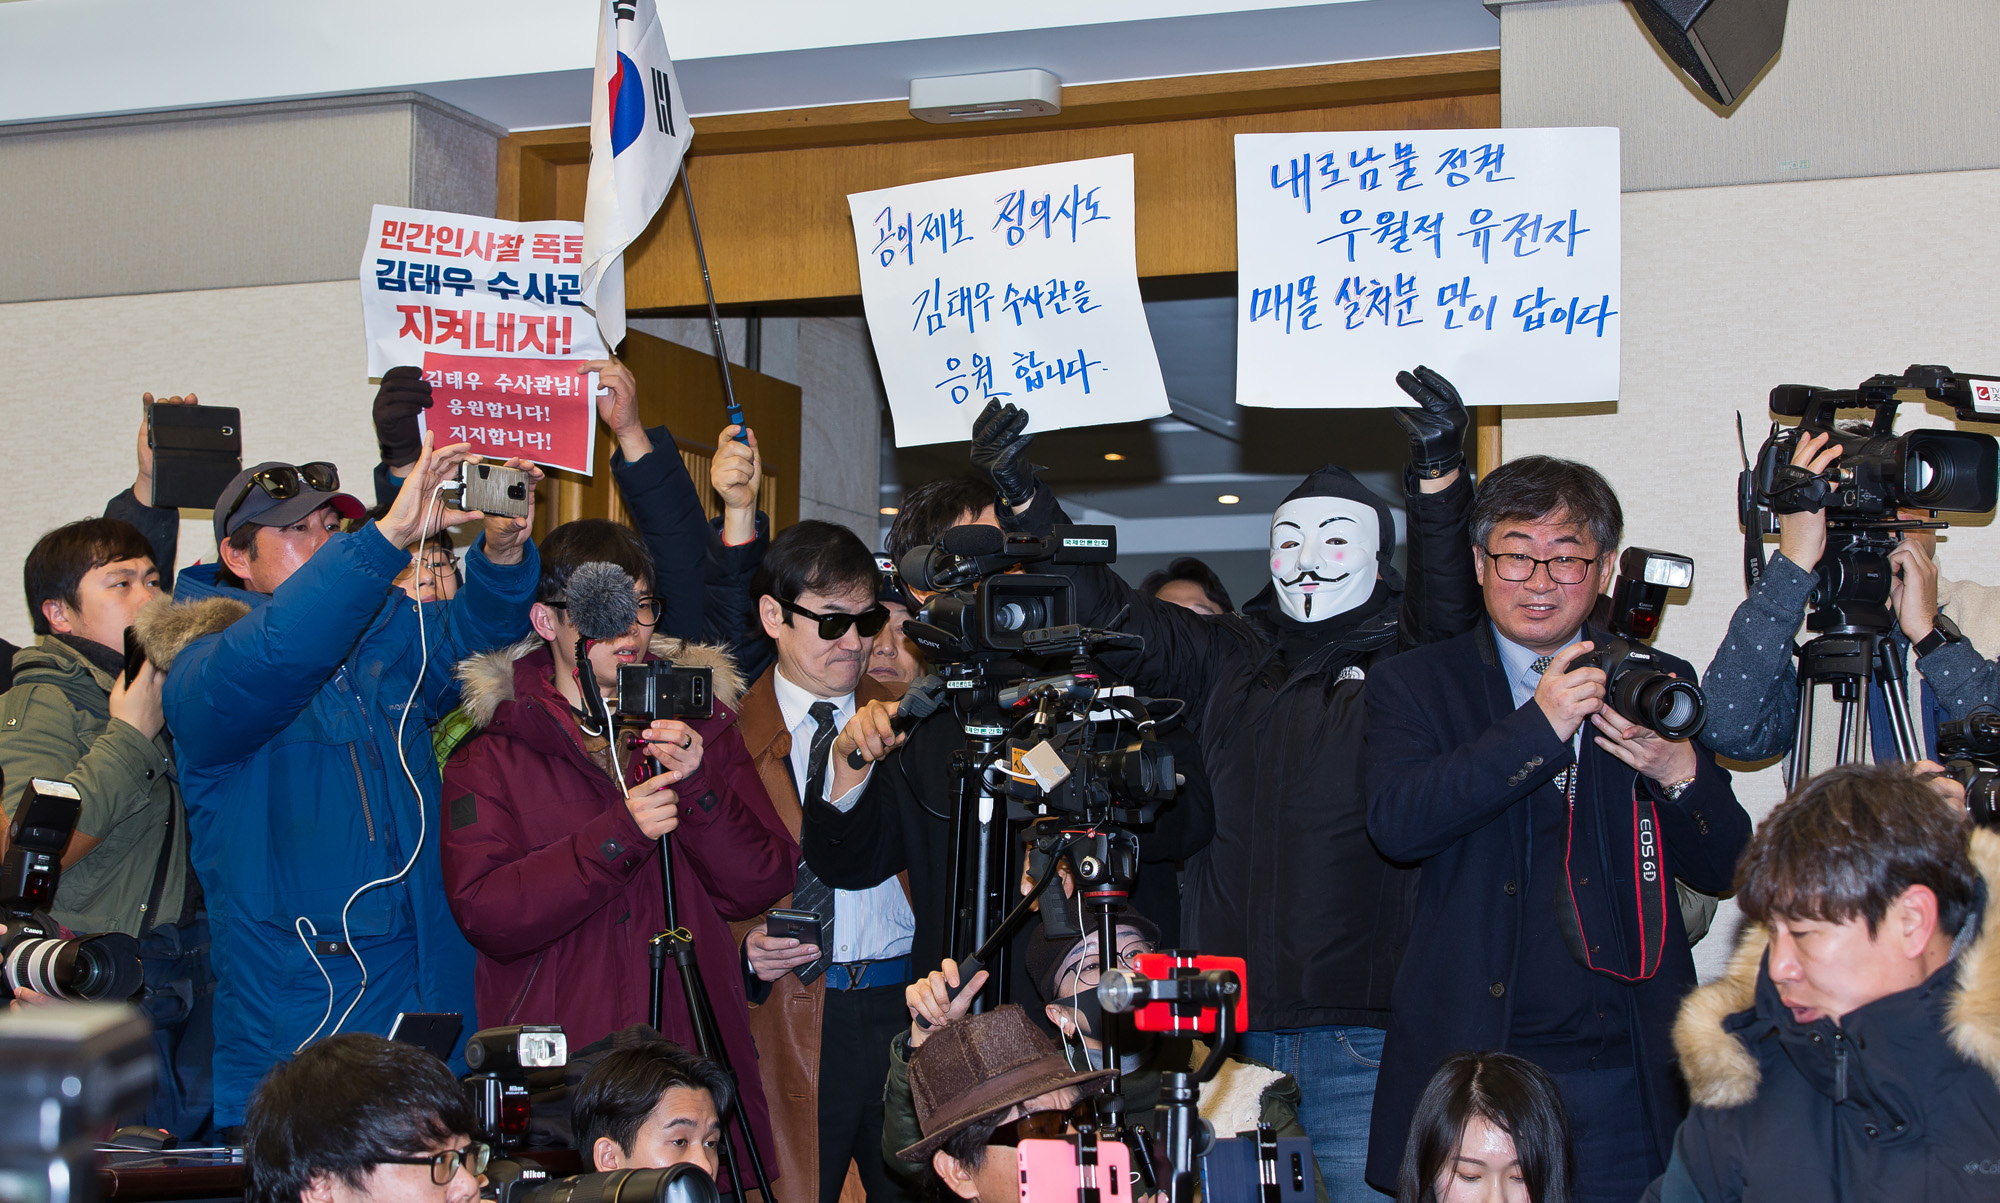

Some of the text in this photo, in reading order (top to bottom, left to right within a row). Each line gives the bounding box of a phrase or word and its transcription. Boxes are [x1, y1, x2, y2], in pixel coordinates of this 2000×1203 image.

[1272, 143, 1514, 213] 내로남불 정권
[380, 220, 524, 262] 민간인사찰
[872, 184, 1110, 267] 공익제보 정의사도
[1317, 209, 1590, 264] 우월적 유전자
[376, 259, 474, 296] 김태우
[913, 278, 1101, 335] 김태우 수사관을
[1250, 273, 1618, 337] 매몰 살처분 만이 답이다
[397, 305, 571, 354] 지켜내자!
[426, 370, 579, 396] 김태우 수사관님!
[936, 353, 1012, 404] 응원
[448, 399, 550, 421] 응원합니다!
[450, 426, 551, 450] 지지합니다!
[917, 637, 940, 649] SONY
[1629, 652, 1651, 660] Canon
[1640, 818, 1657, 882] EOS 6D
[23, 926, 44, 935] Canon
[522, 1170, 546, 1179] Nikon
